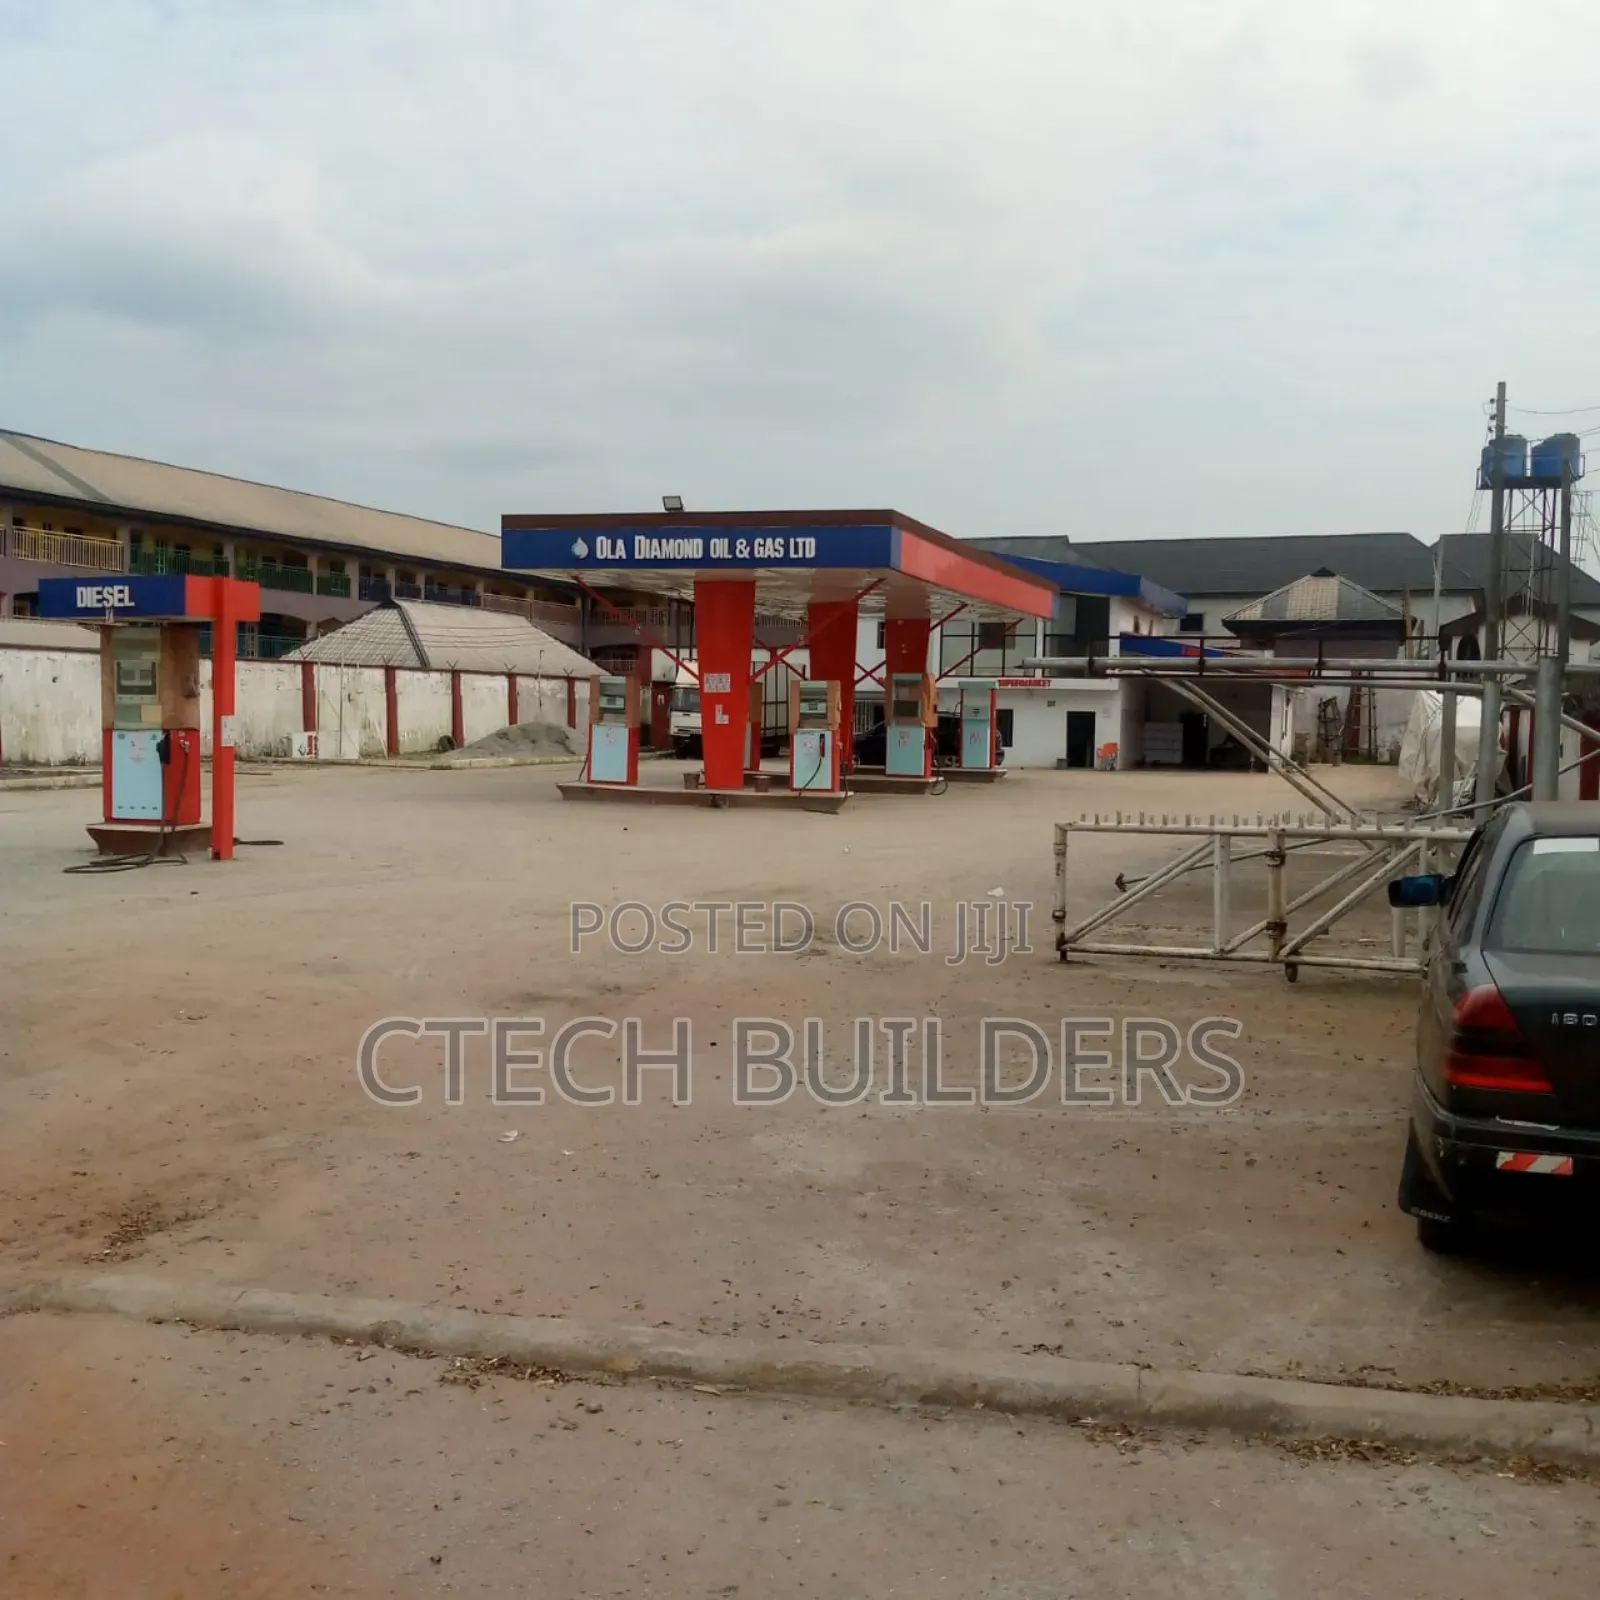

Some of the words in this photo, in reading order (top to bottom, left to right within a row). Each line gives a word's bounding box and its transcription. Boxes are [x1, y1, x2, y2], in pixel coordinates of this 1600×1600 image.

[595, 535, 627, 561] OLA
[634, 534, 704, 561] DIAMOND
[709, 537, 732, 560] OIL
[735, 537, 750, 560] &
[754, 536, 785, 559] GAS
[789, 536, 817, 559] LTD
[76, 585, 136, 608] DIESEL
